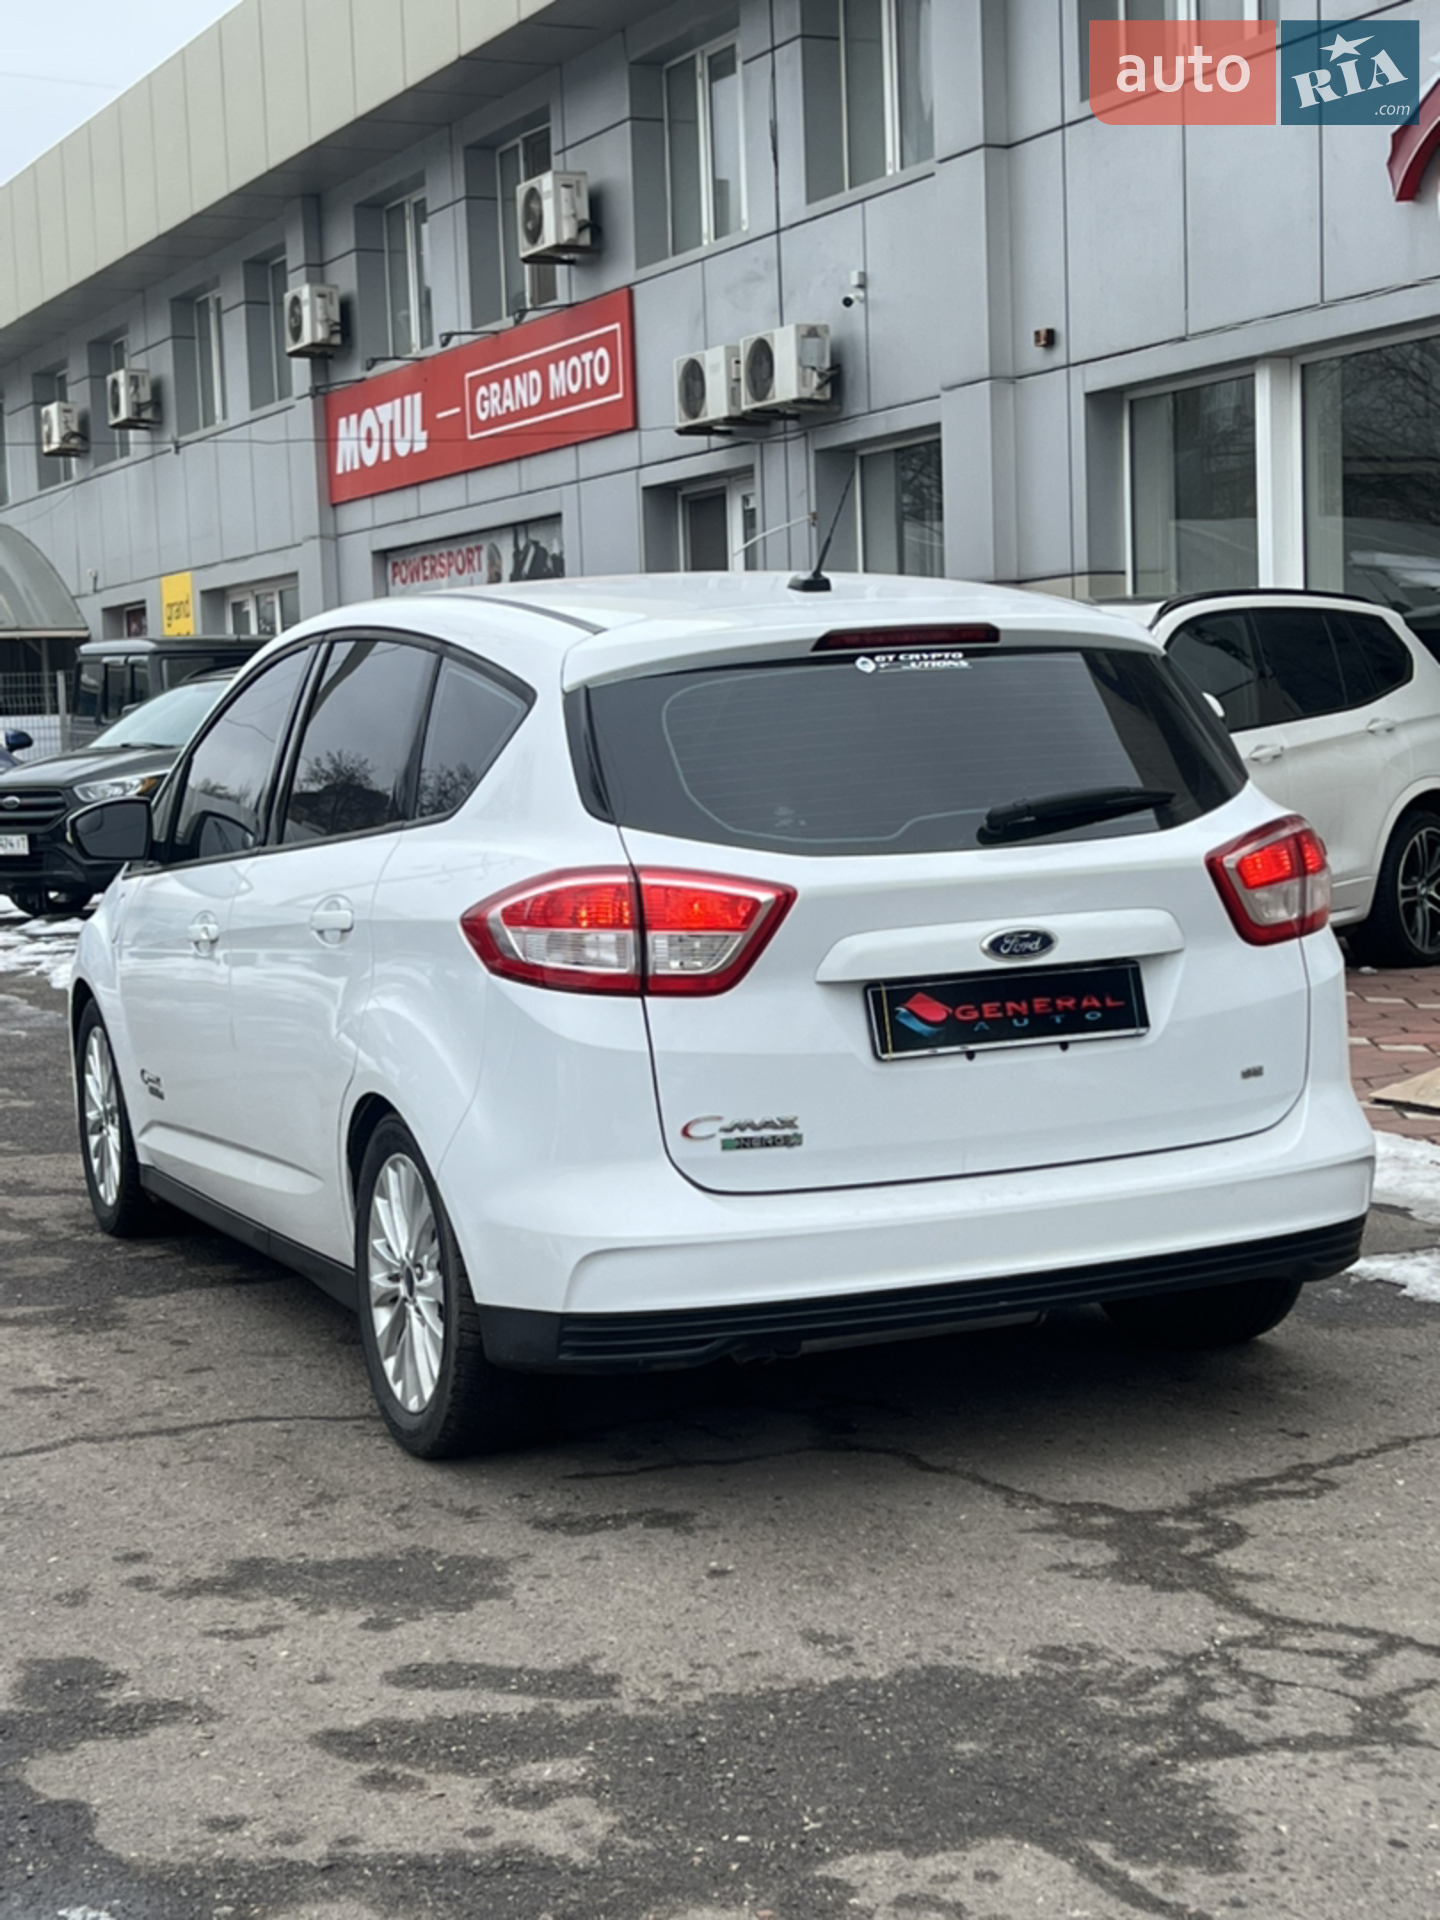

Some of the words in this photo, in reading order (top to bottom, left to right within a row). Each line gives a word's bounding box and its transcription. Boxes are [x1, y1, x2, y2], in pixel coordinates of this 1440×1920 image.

[336, 392, 427, 475] MOTUL
[475, 369, 542, 421] GRAND
[549, 347, 611, 400] MOTO
[391, 545, 483, 586] POWERSPORT
[166, 593, 190, 628] grand
[1000, 931, 1042, 954] Ford
[955, 994, 1125, 1020] GENERAL
[974, 1011, 1102, 1032] AUTO
